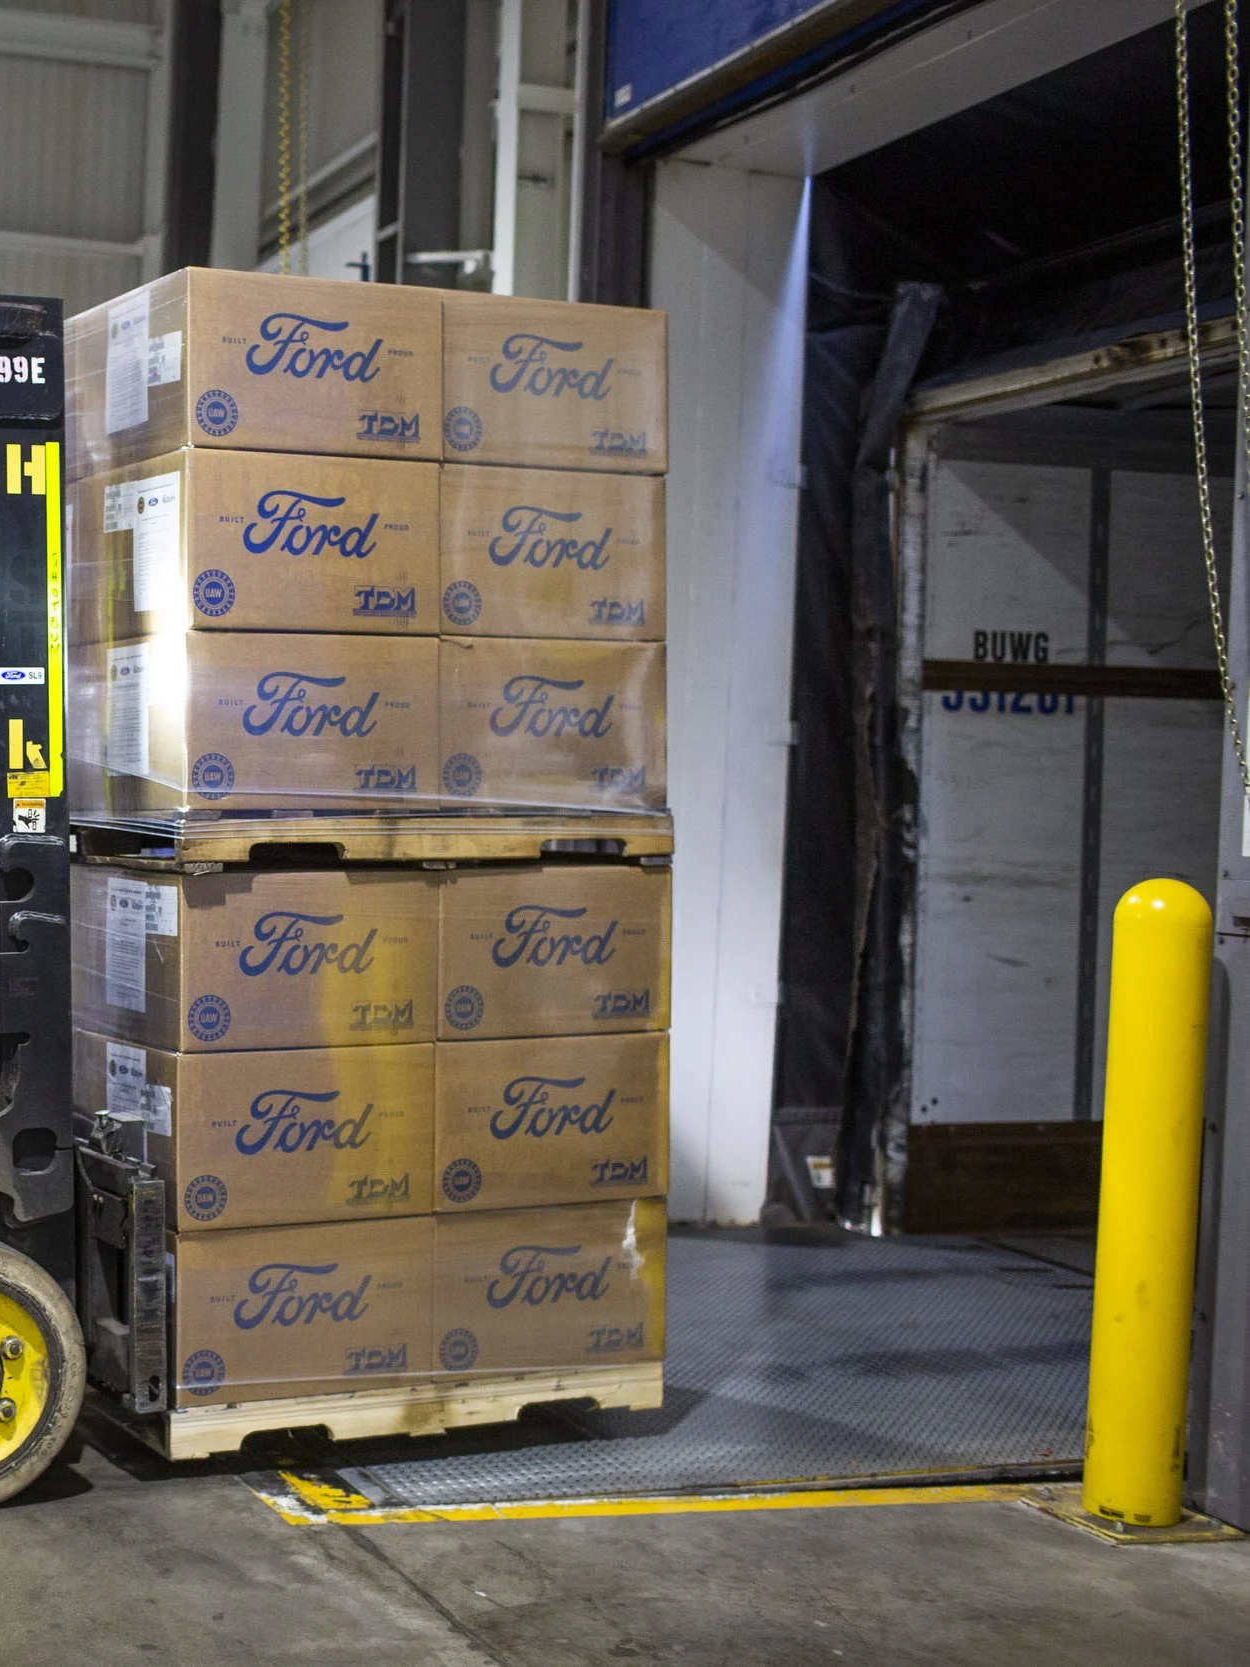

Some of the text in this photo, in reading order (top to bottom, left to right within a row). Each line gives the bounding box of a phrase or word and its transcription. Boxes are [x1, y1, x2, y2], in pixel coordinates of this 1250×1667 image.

[222, 313, 413, 383] BUILT Ford PROUD
[490, 333, 614, 400] Ford
[357, 412, 420, 437] TDM
[219, 490, 410, 558] BUILT Ford PROUD
[489, 505, 613, 570] Ford
[205, 589, 223, 598] UAW
[354, 586, 416, 611] TDM
[590, 598, 644, 620] TDM
[974, 630, 1049, 662] BUWG
[242, 672, 380, 737] Ford
[489, 675, 615, 738] Ford
[354, 765, 417, 791] TDM
[239, 912, 378, 977] Ford
[492, 905, 618, 968] Ford
[200, 1014, 218, 1023] UAW
[352, 1000, 414, 1027] TDM
[594, 989, 649, 1015] TDM
[211, 1120, 237, 1128] BUILT
[235, 1090, 374, 1155] Ford
[490, 1076, 616, 1140] Ford
[348, 1173, 410, 1201] TDM
[591, 1156, 647, 1181] TDM
[234, 1264, 372, 1329] Ford
[486, 1245, 612, 1308] Ford
